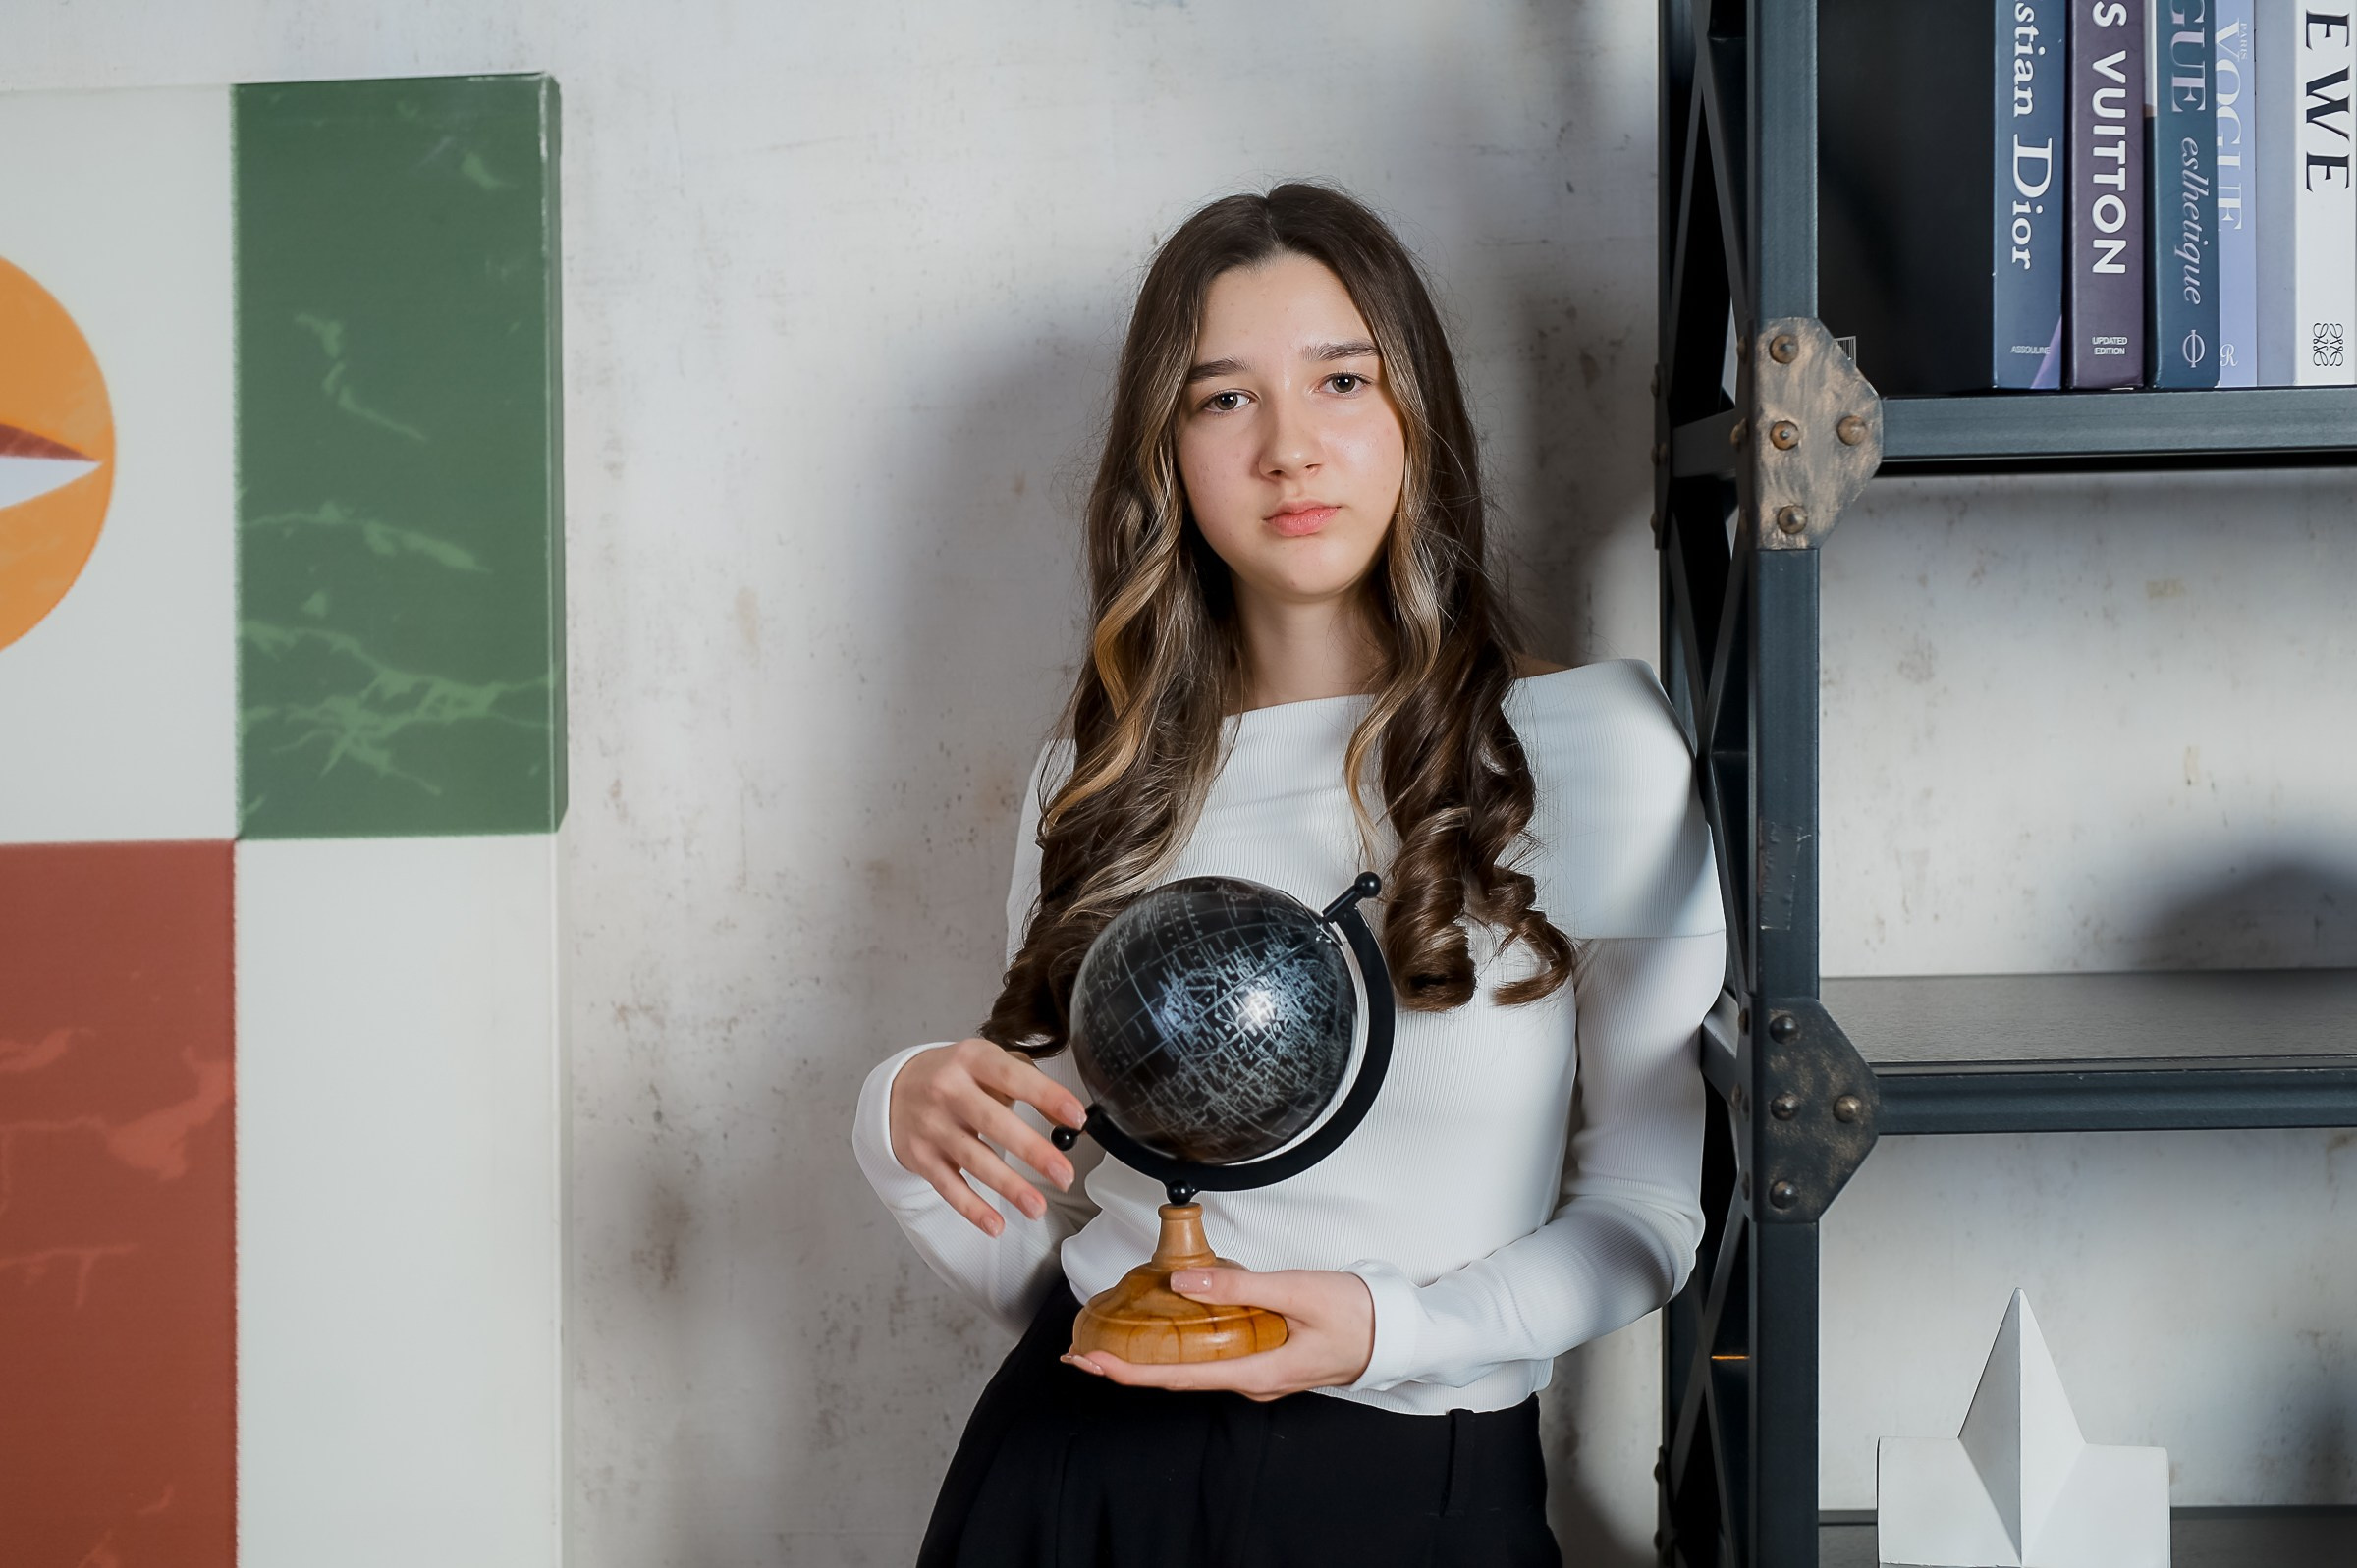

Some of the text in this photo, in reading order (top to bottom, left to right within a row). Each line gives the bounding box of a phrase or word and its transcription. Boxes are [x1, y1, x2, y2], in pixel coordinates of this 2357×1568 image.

[2305, 8, 2350, 193] EWE
[2091, 0, 2127, 275] S VUITTON
[2011, 134, 2054, 270] Dior
[2010, 345, 2052, 355] ASSOULINE
[2092, 336, 2128, 346] UPDATED
[2094, 347, 2126, 356] EDITION
